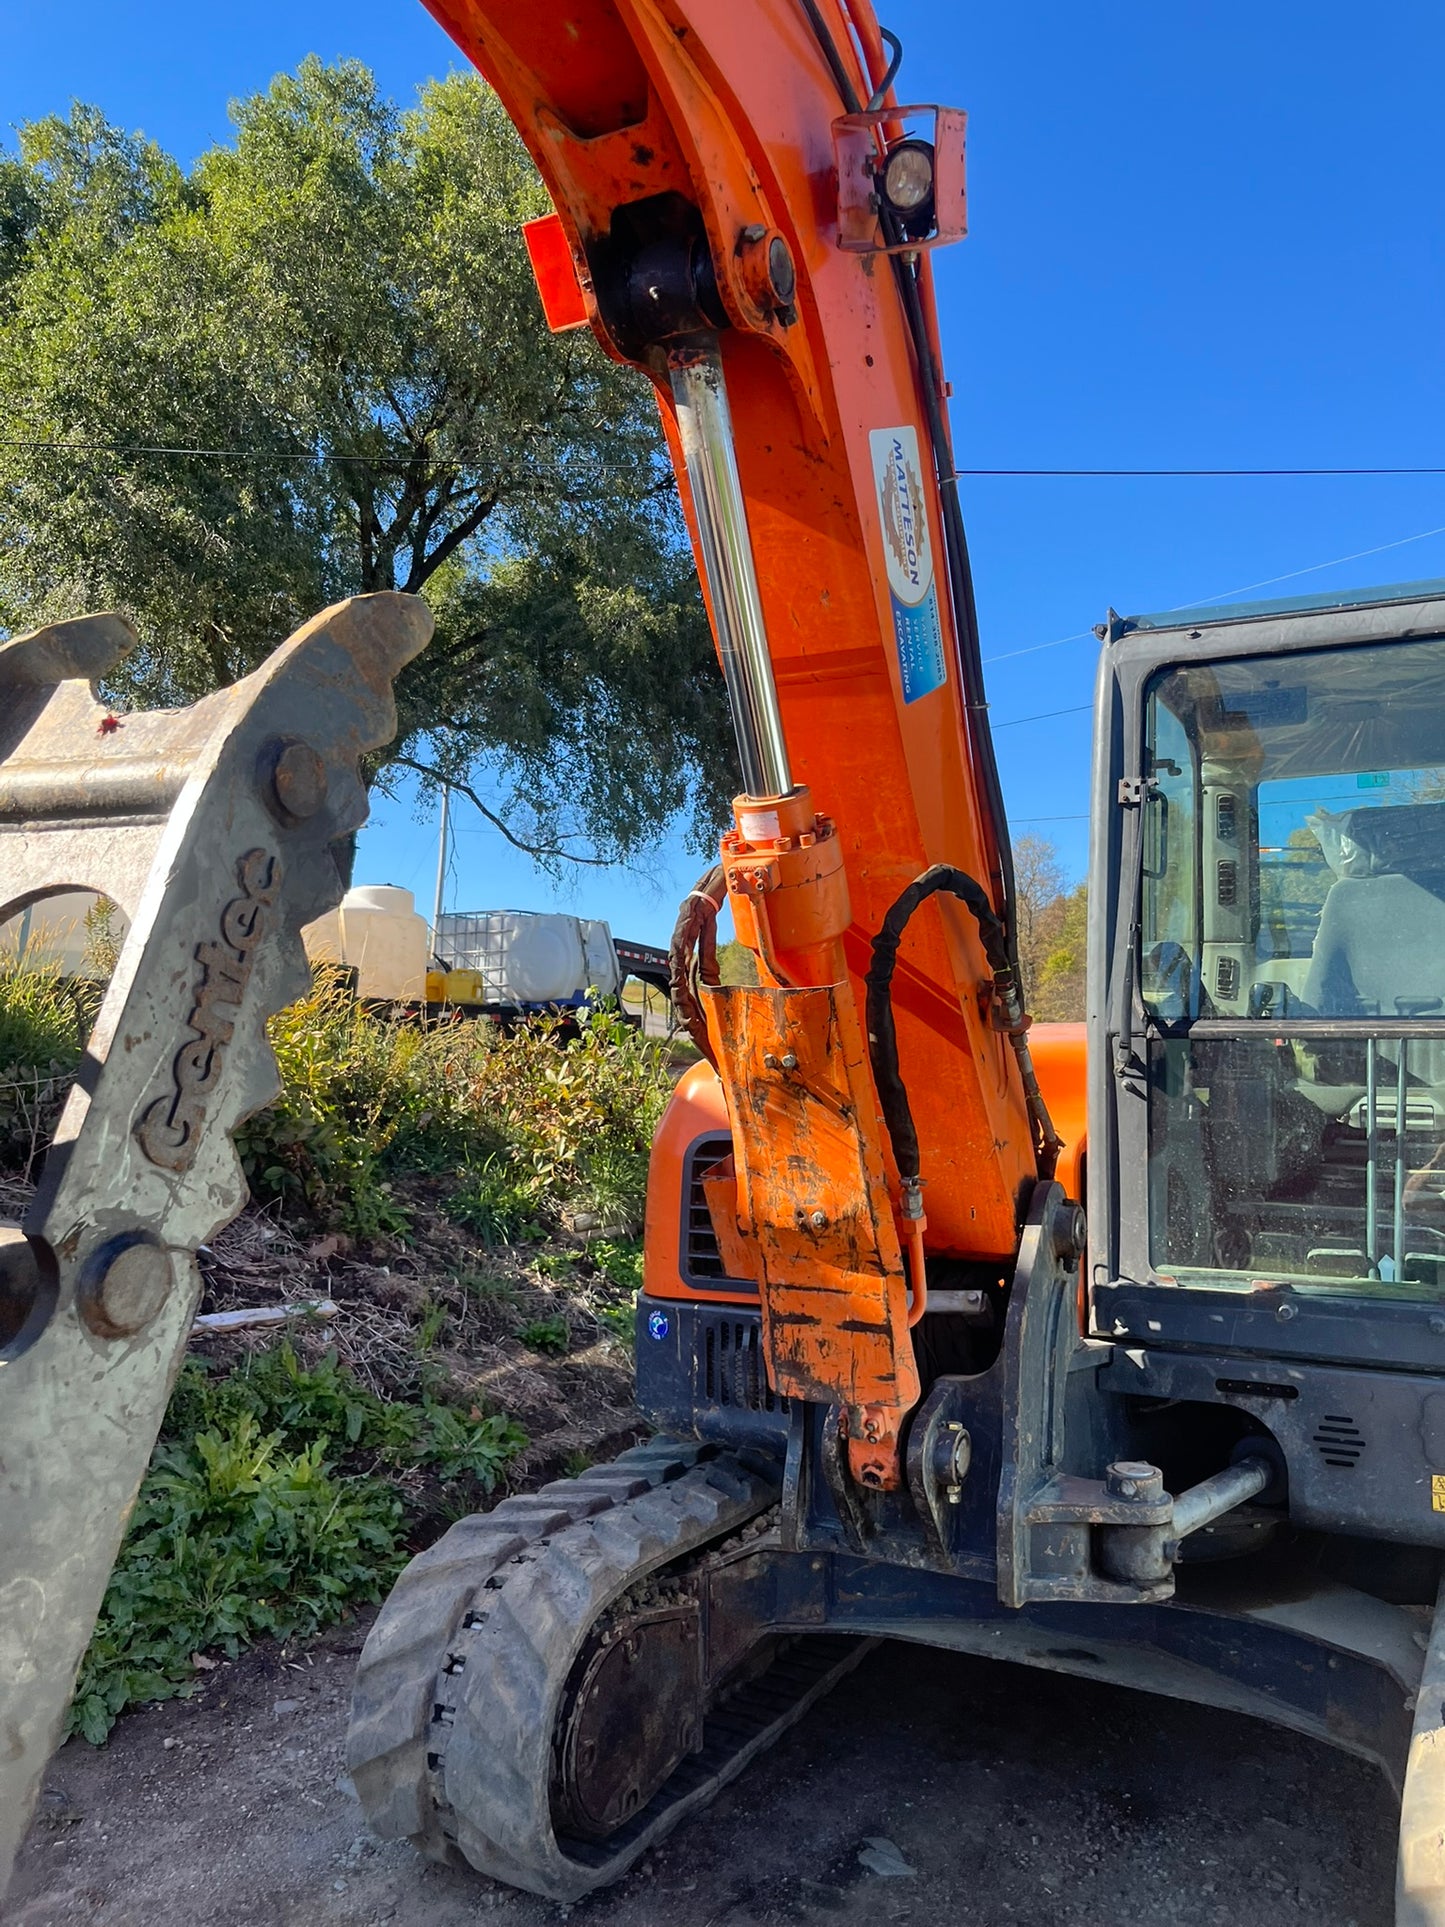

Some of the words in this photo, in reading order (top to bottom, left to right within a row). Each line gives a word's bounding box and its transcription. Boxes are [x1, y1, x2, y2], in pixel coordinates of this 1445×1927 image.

[893, 438, 919, 585] MATTESON
[896, 611, 911, 693] EXCAVATING
[905, 617, 916, 669] RENTAL
[913, 618, 924, 672] SERVICE
[644, 952, 653, 964] PJ
